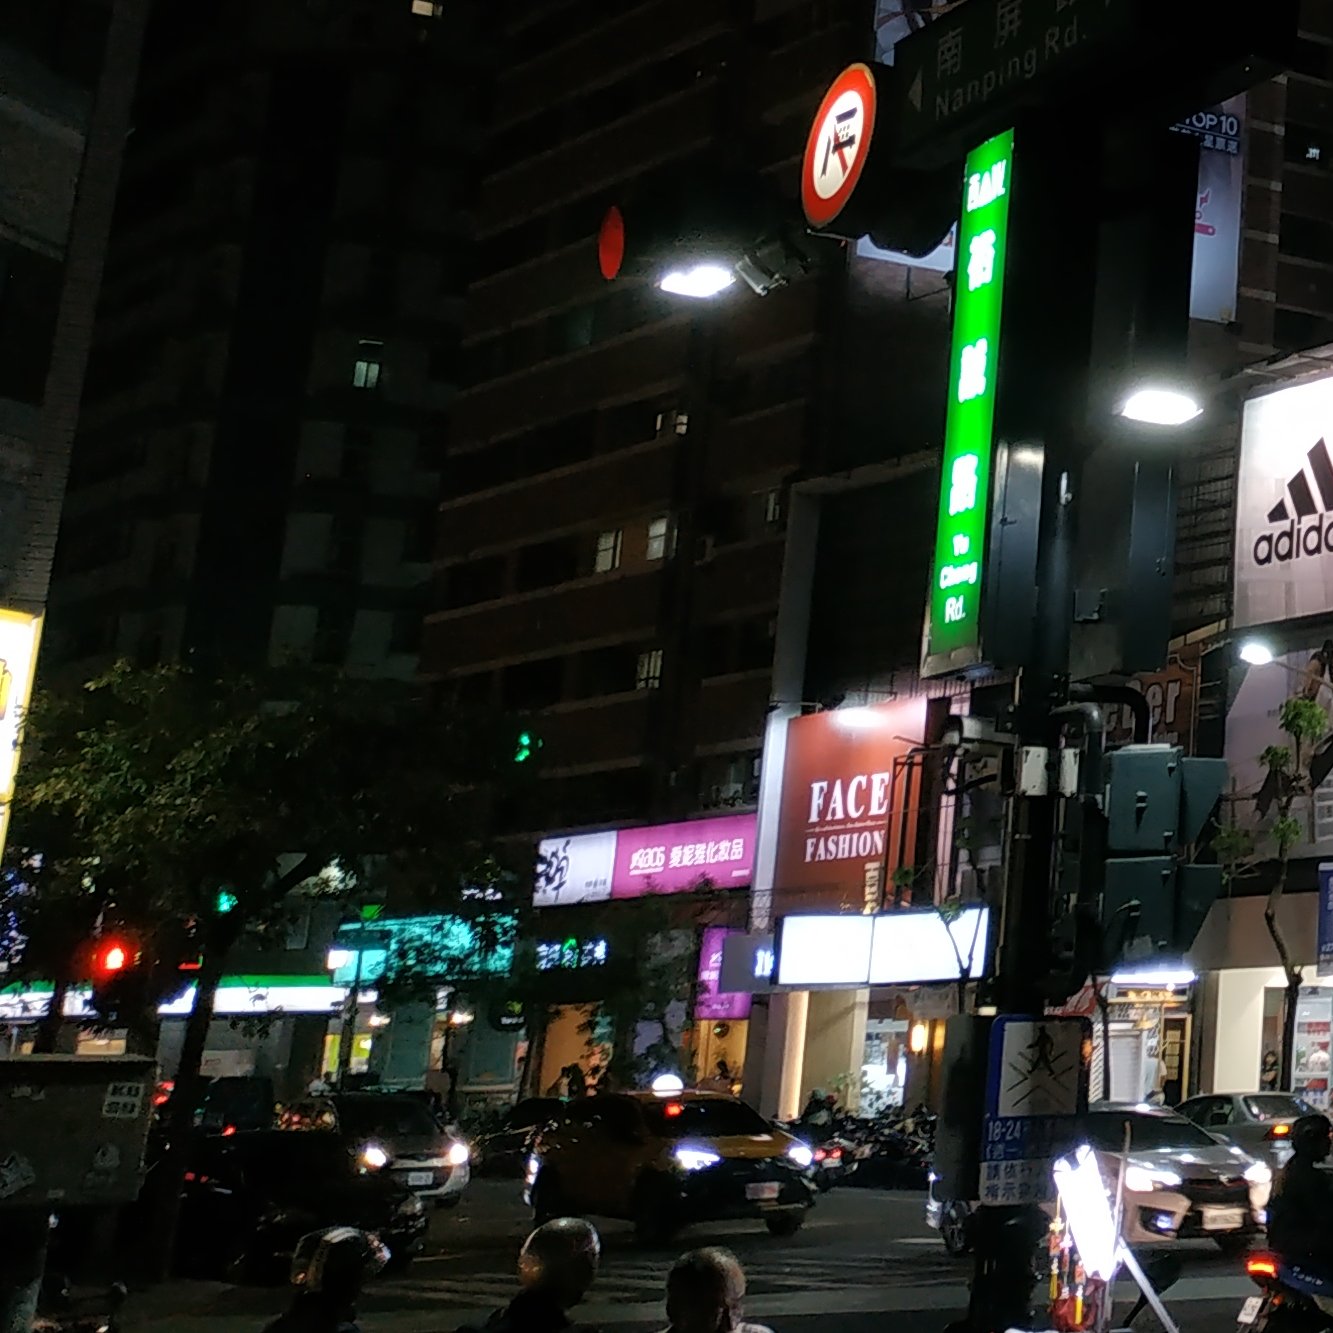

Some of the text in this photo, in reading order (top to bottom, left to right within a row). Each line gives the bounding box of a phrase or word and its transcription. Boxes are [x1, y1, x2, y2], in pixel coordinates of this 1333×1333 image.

[935, 15, 1088, 120] Nanping Rd.
[1220, 115, 1238, 136] 10
[944, 595, 966, 623] Rd.
[807, 771, 890, 824] FACE
[804, 829, 886, 863] FASHION
